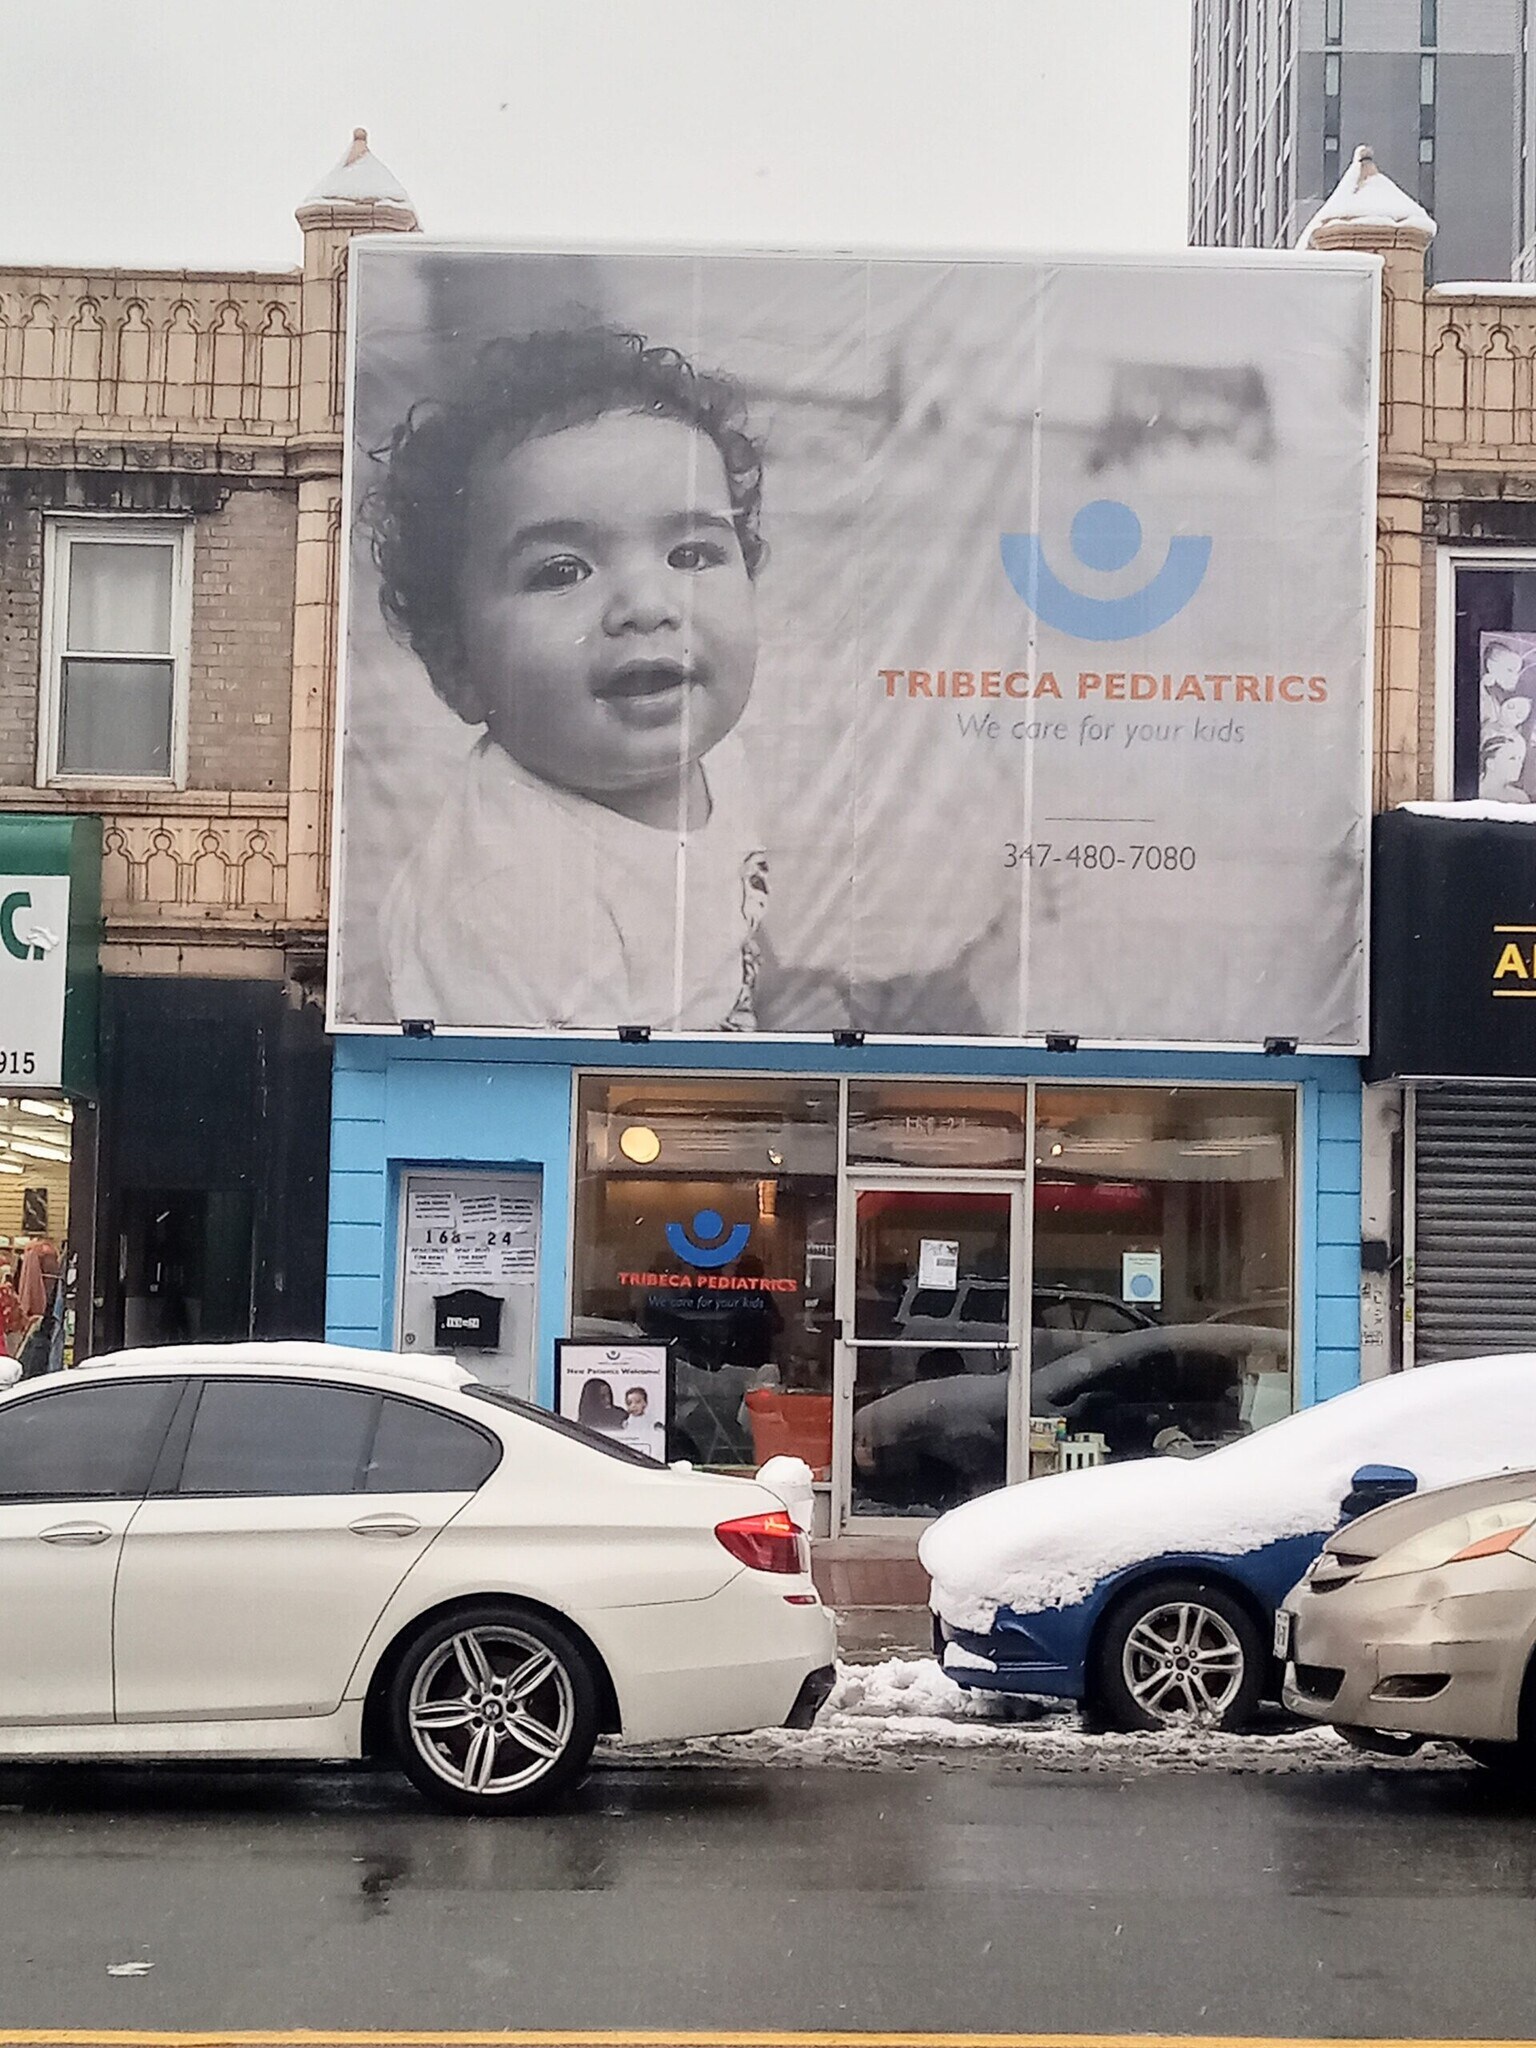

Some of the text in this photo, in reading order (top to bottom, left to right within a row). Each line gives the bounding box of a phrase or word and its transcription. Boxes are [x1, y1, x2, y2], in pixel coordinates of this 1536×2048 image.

[878, 669, 1329, 703] TRIBECA PEDIATRICS
[957, 712, 1246, 748] We care for your kids
[1003, 843, 1196, 872] 347-480-7080
[1493, 943, 1536, 979] A
[618, 1272, 798, 1292] TRIBECA PEDIATRICS
[649, 1296, 764, 1311] We care for your kids
